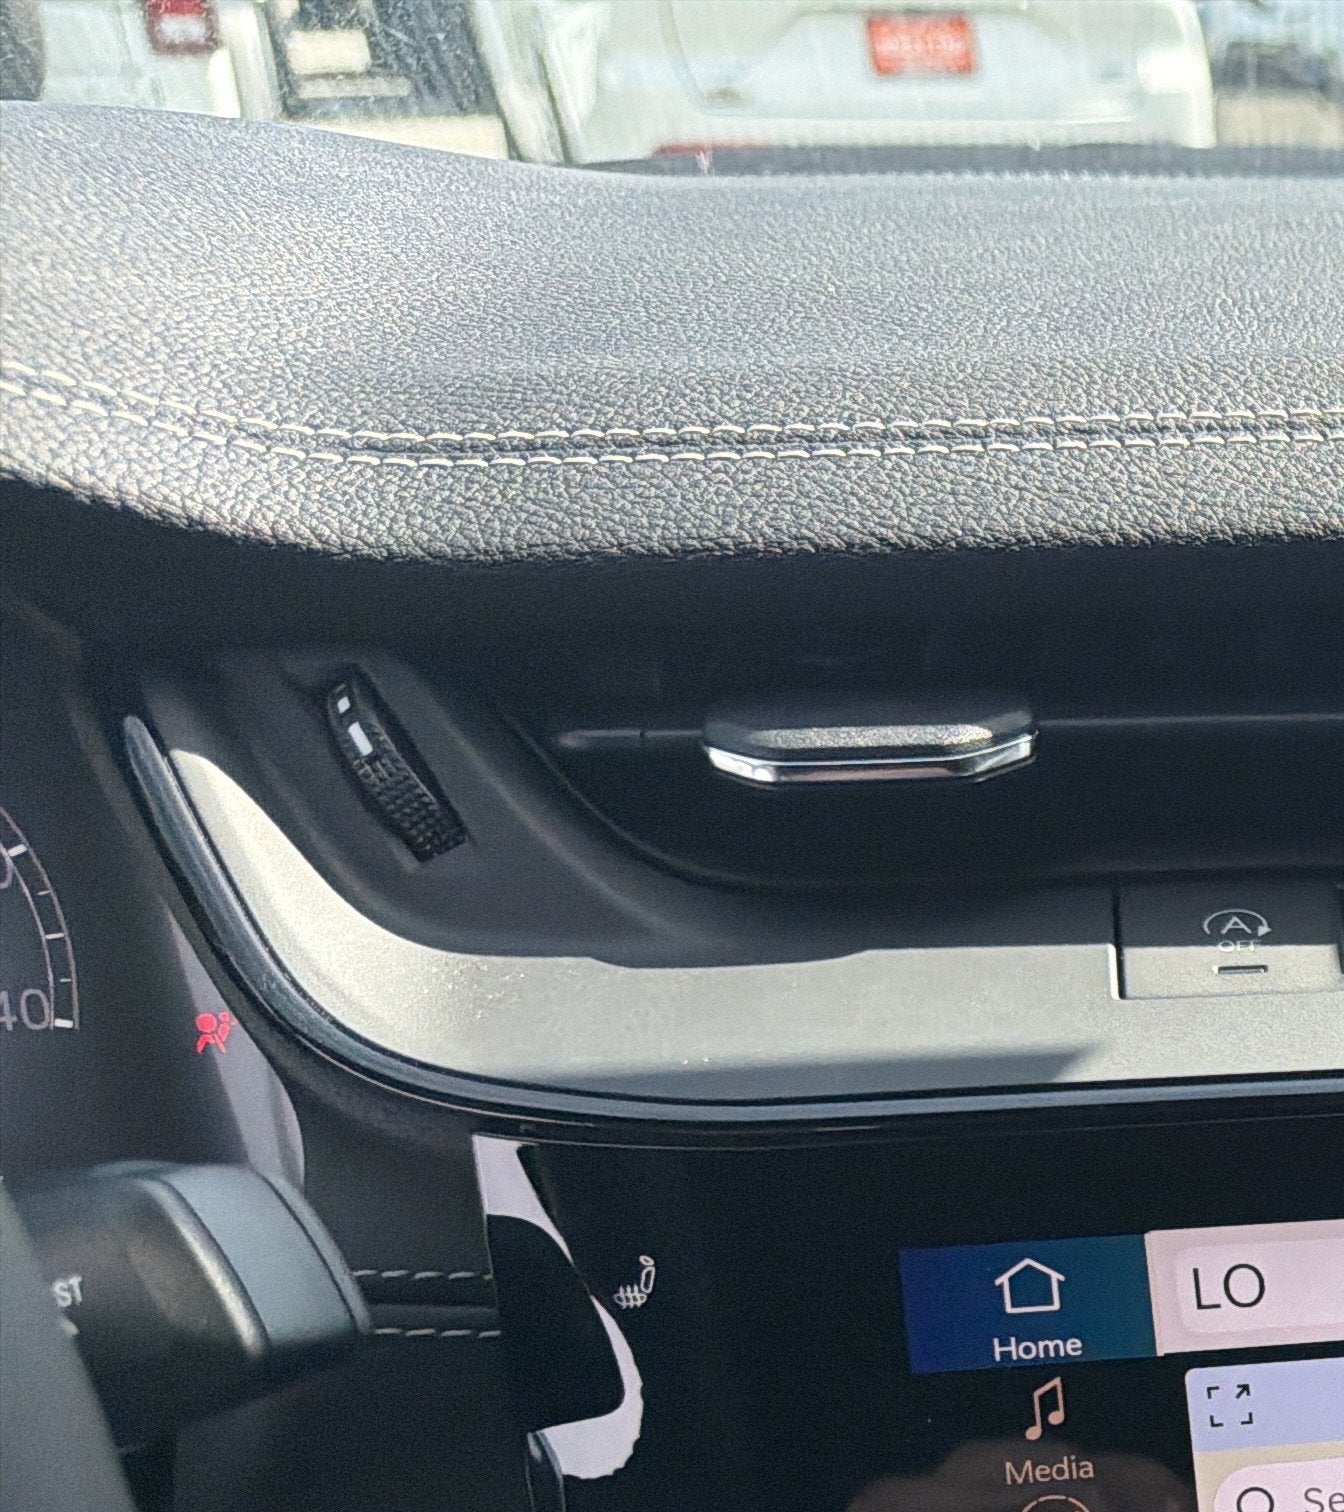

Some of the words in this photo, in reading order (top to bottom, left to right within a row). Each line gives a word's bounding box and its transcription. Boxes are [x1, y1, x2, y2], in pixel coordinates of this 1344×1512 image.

[1216, 939, 1263, 953] OFF
[1191, 1262, 1266, 1311] LO
[993, 1336, 1083, 1363] Home
[1005, 1455, 1095, 1485] Media
